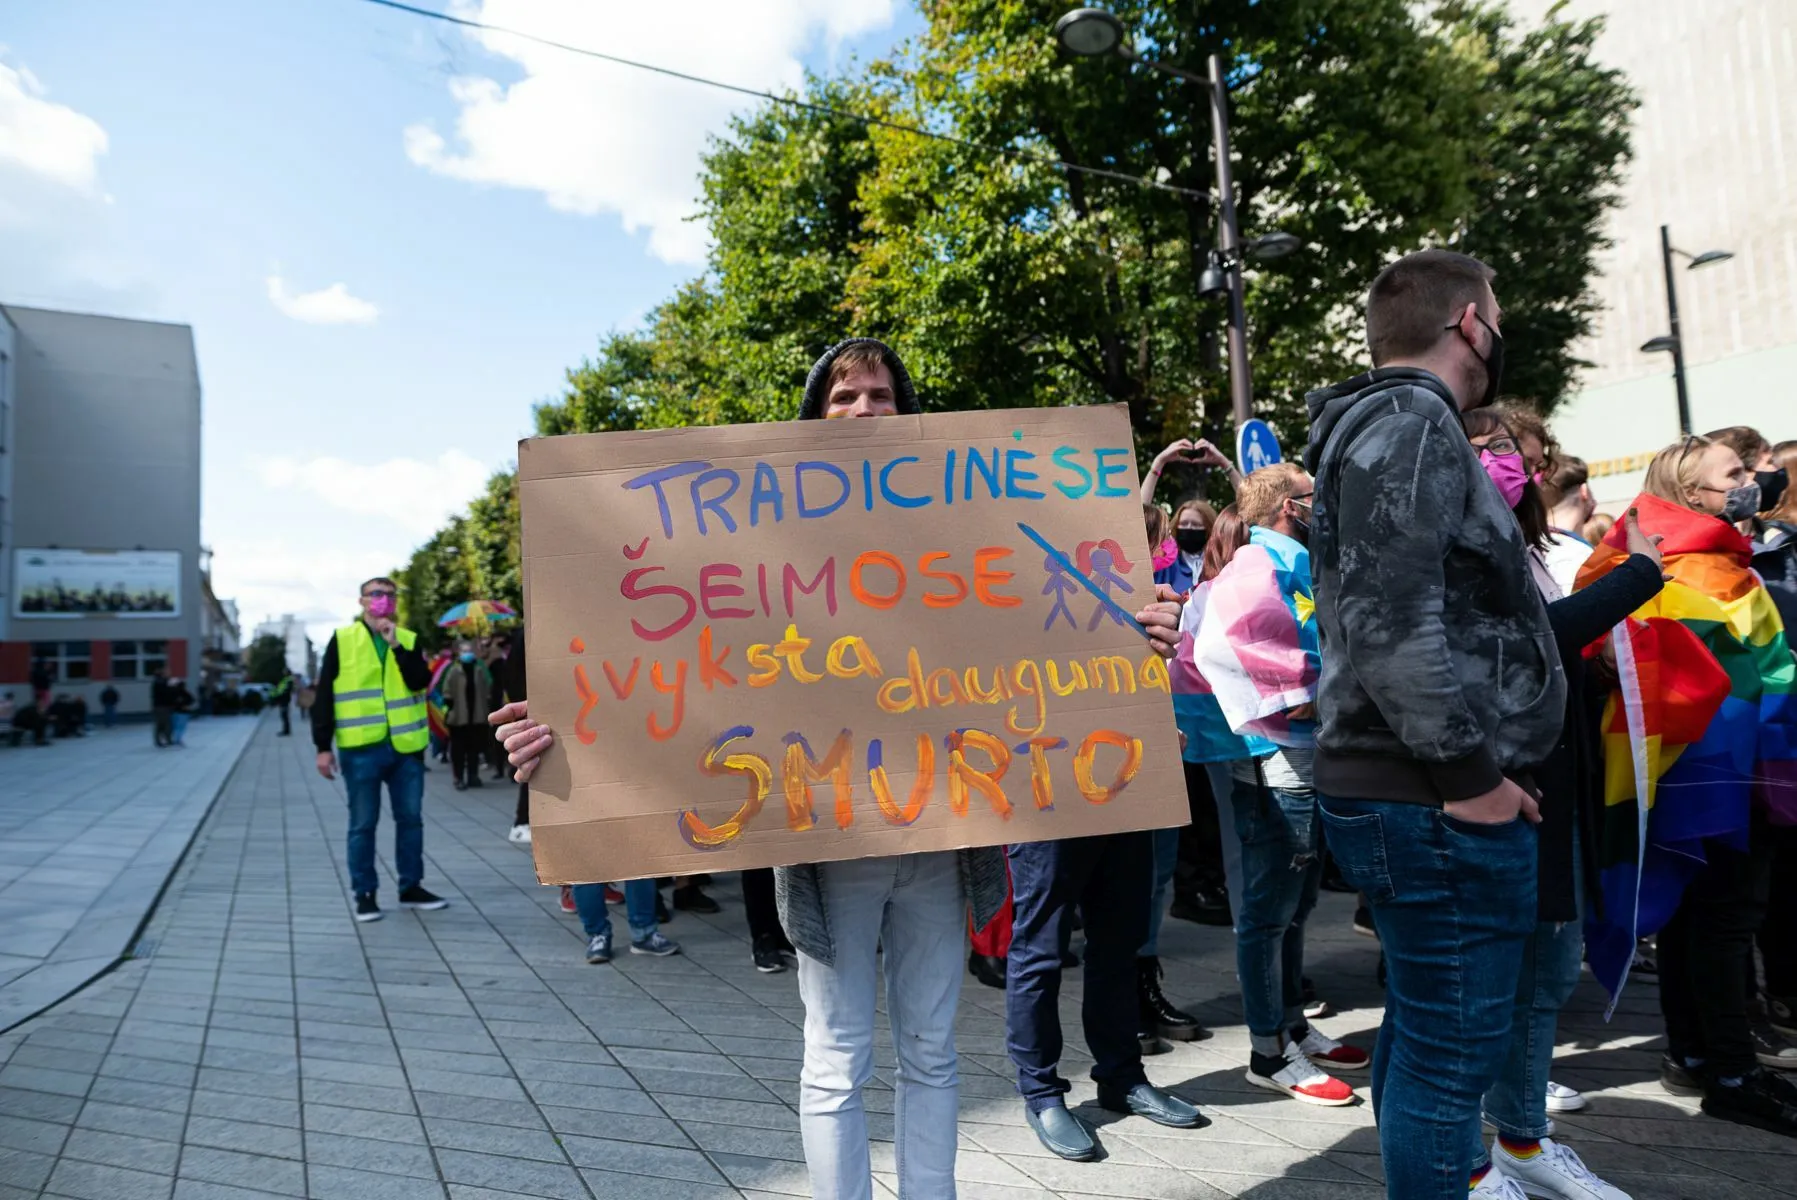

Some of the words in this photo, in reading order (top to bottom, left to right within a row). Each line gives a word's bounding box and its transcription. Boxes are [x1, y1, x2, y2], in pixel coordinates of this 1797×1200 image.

[622, 431, 1131, 539] TRADICINĖSE
[621, 536, 1023, 641] ŠEIMOSE
[570, 623, 884, 744] įvyksta
[875, 646, 1171, 734] dauguma
[678, 725, 1143, 850] SMURTO
